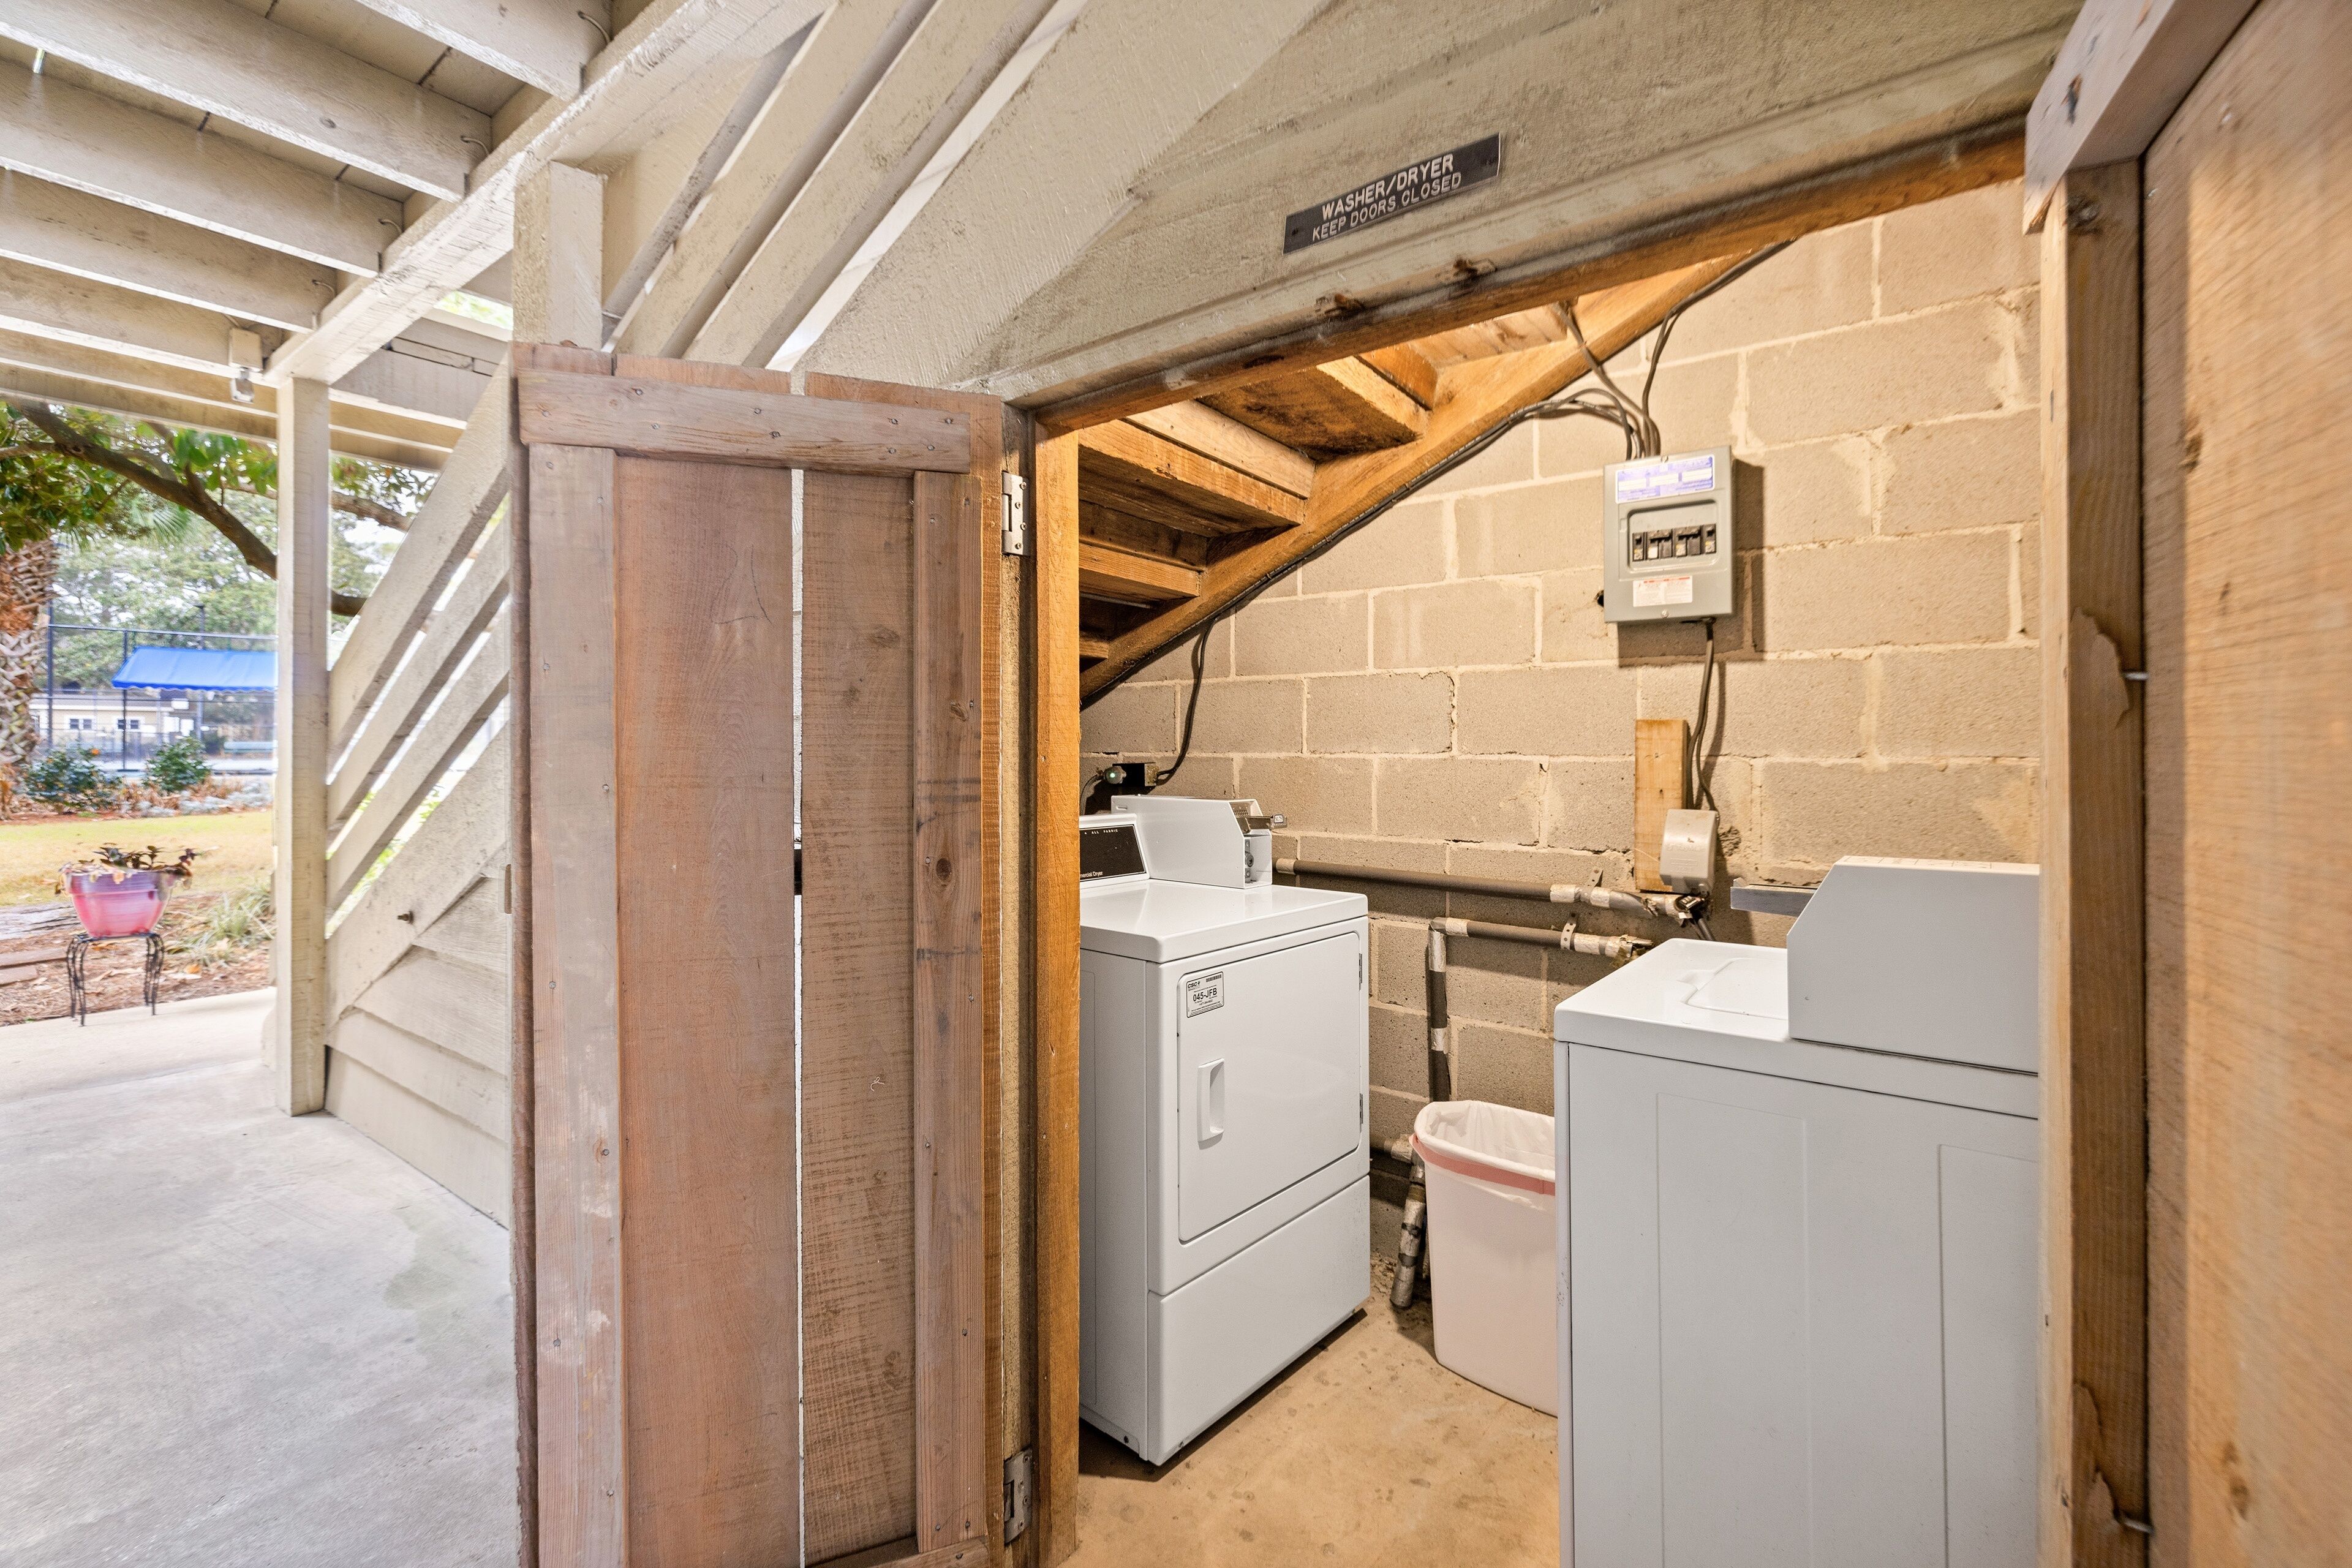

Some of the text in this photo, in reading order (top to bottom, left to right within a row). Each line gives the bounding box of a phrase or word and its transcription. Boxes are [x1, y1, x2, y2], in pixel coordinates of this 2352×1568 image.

[1312, 172, 1461, 242] KEEP DOORS CLOSED
[1322, 153, 1454, 221] WASHER/DRYER
[1193, 988, 1217, 1001] 045-JFB
